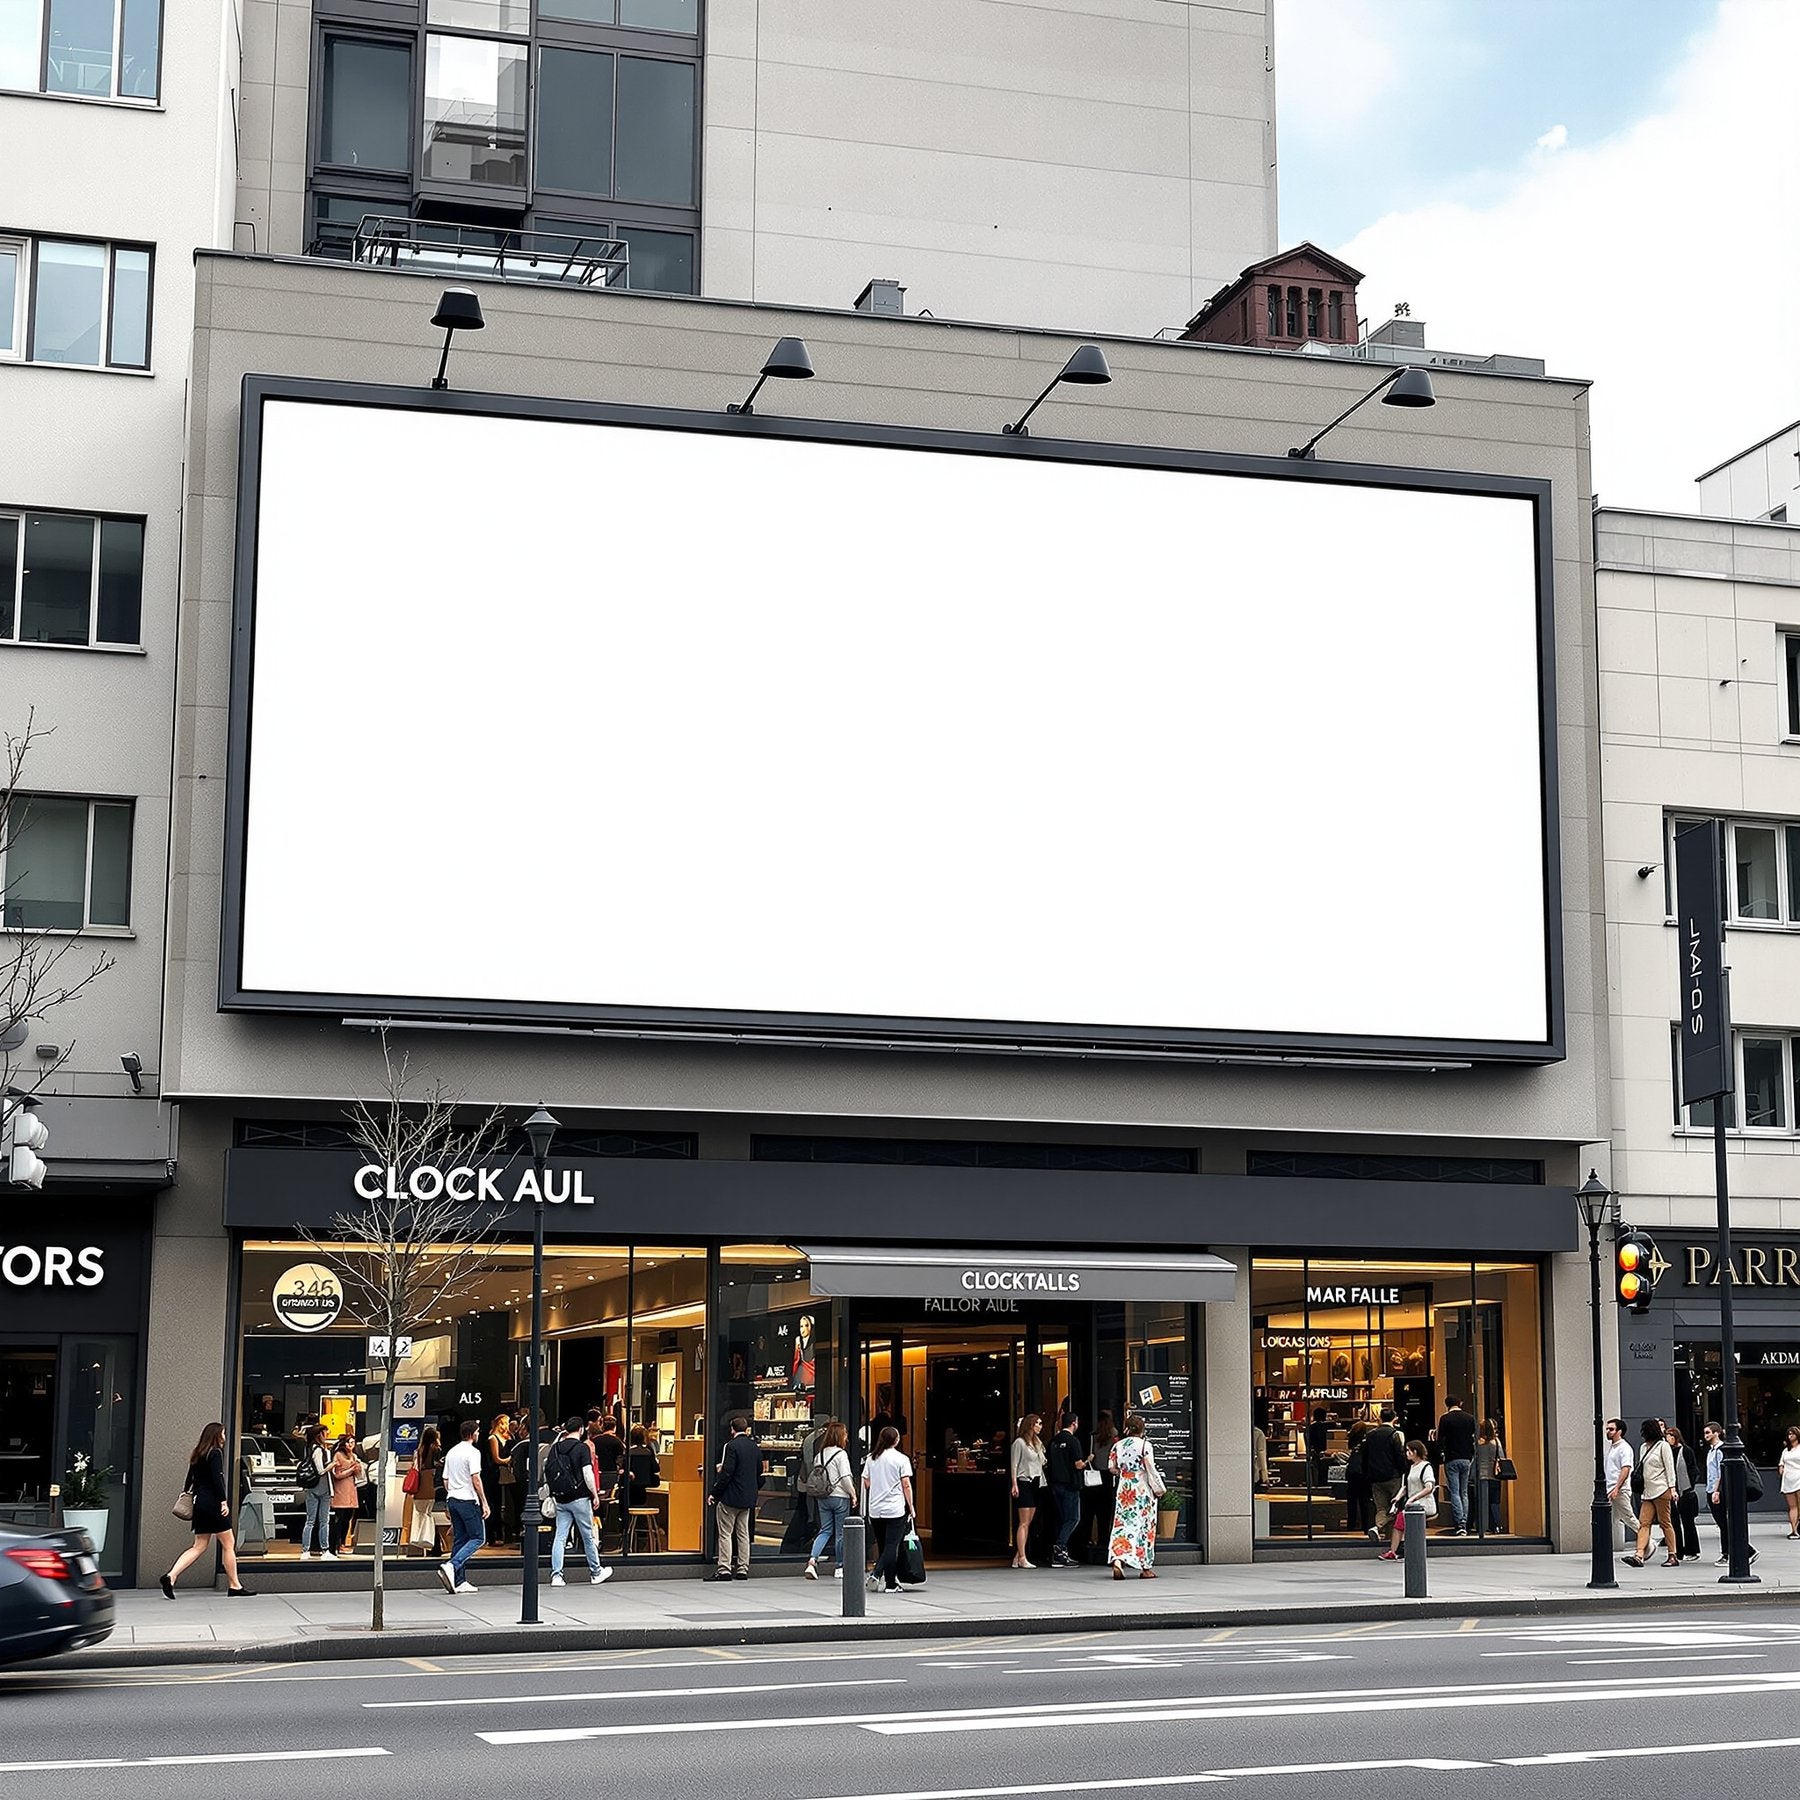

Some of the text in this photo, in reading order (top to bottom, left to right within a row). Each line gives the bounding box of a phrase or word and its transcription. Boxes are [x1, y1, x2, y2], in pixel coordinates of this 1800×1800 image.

[353, 1164, 596, 1205] CLOCK AUL
[961, 1271, 1081, 1292] CLOCKTALLS
[1307, 1286, 1400, 1304] MAR FALLE
[924, 1298, 981, 1312] FALLOR
[1760, 1351, 1800, 1365] AKDM
